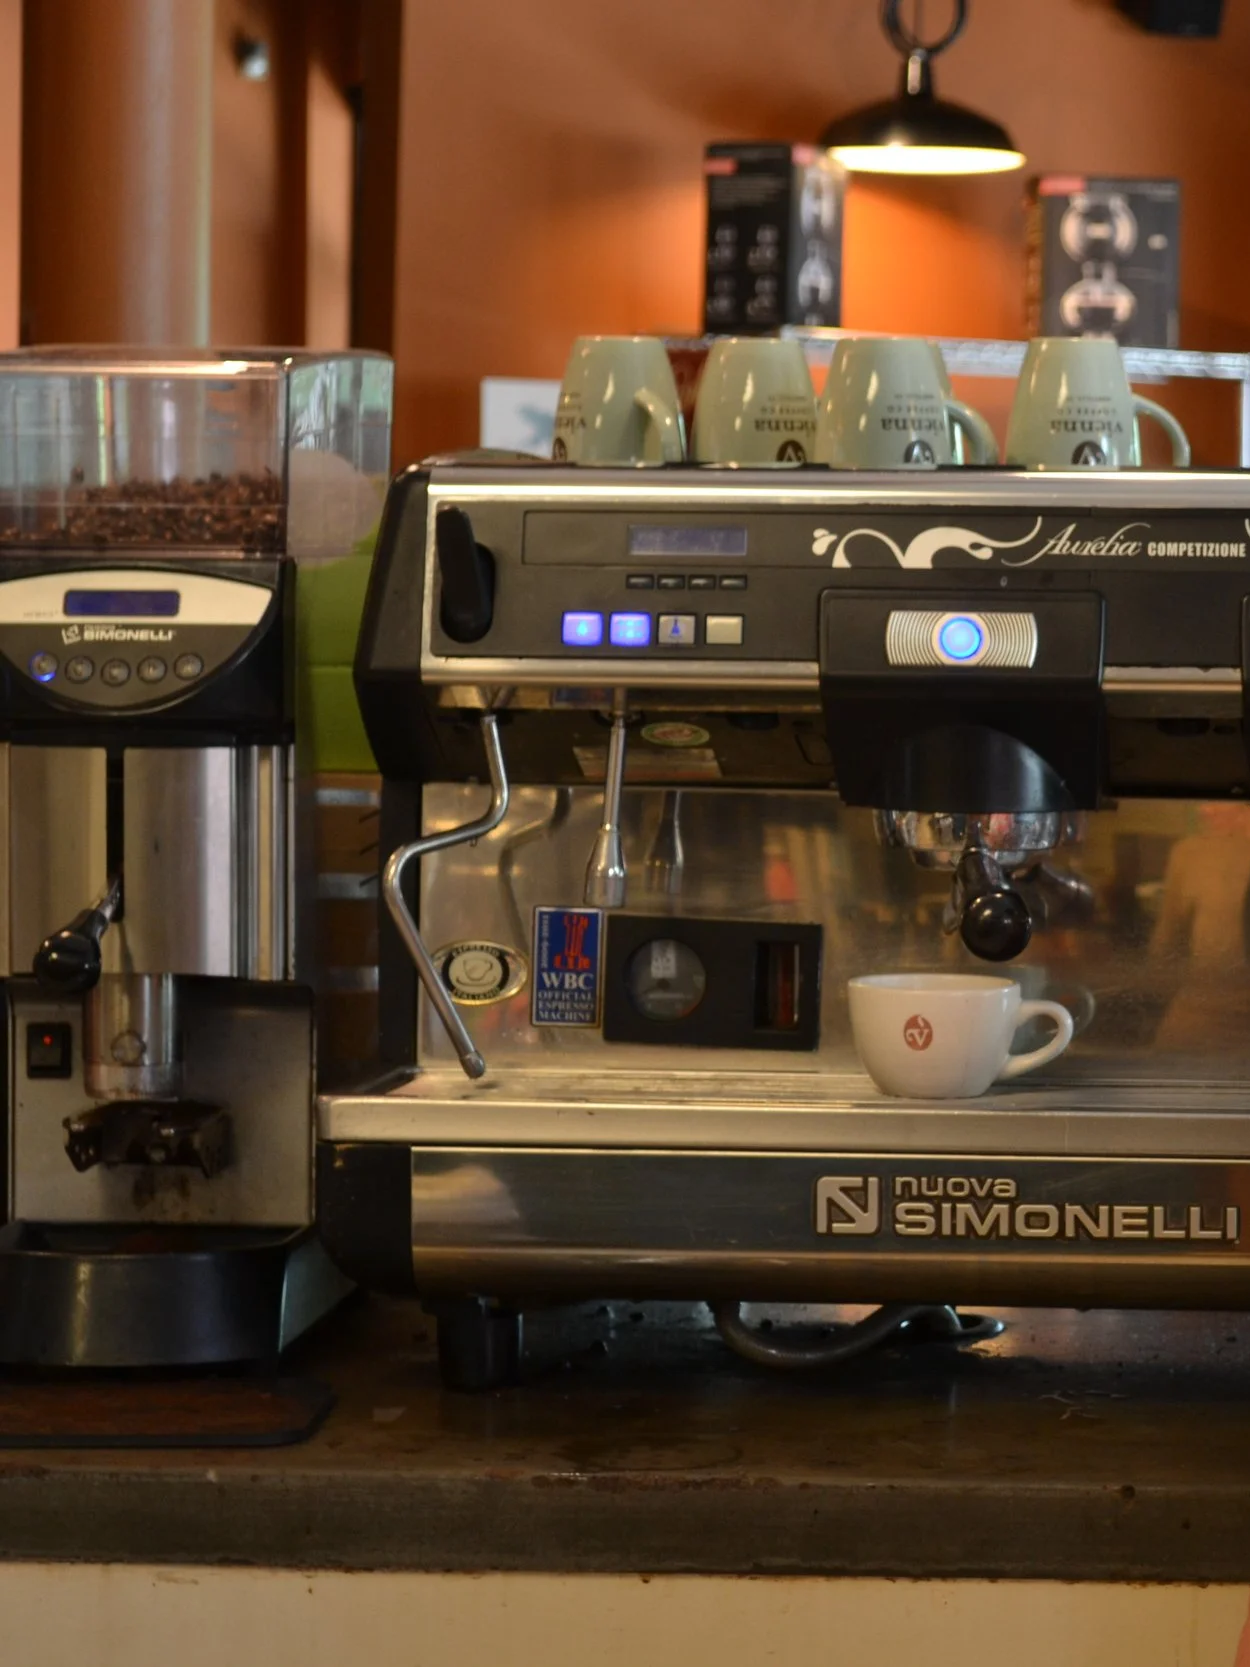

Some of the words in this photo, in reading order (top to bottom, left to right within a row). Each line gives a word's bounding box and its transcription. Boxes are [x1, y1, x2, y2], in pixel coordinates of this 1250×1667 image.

[881, 419, 944, 436] vienna
[1050, 420, 1123, 438] vienna
[1147, 541, 1246, 558] COMPETIZIONE
[541, 972, 594, 990] WBC
[538, 990, 593, 1000] OFFICIAL
[538, 1001, 594, 1011] ESPRESSO
[538, 1011, 591, 1021] MACHINE
[894, 1175, 1017, 1198] nuova
[894, 1202, 1238, 1240] SIMONELLI
